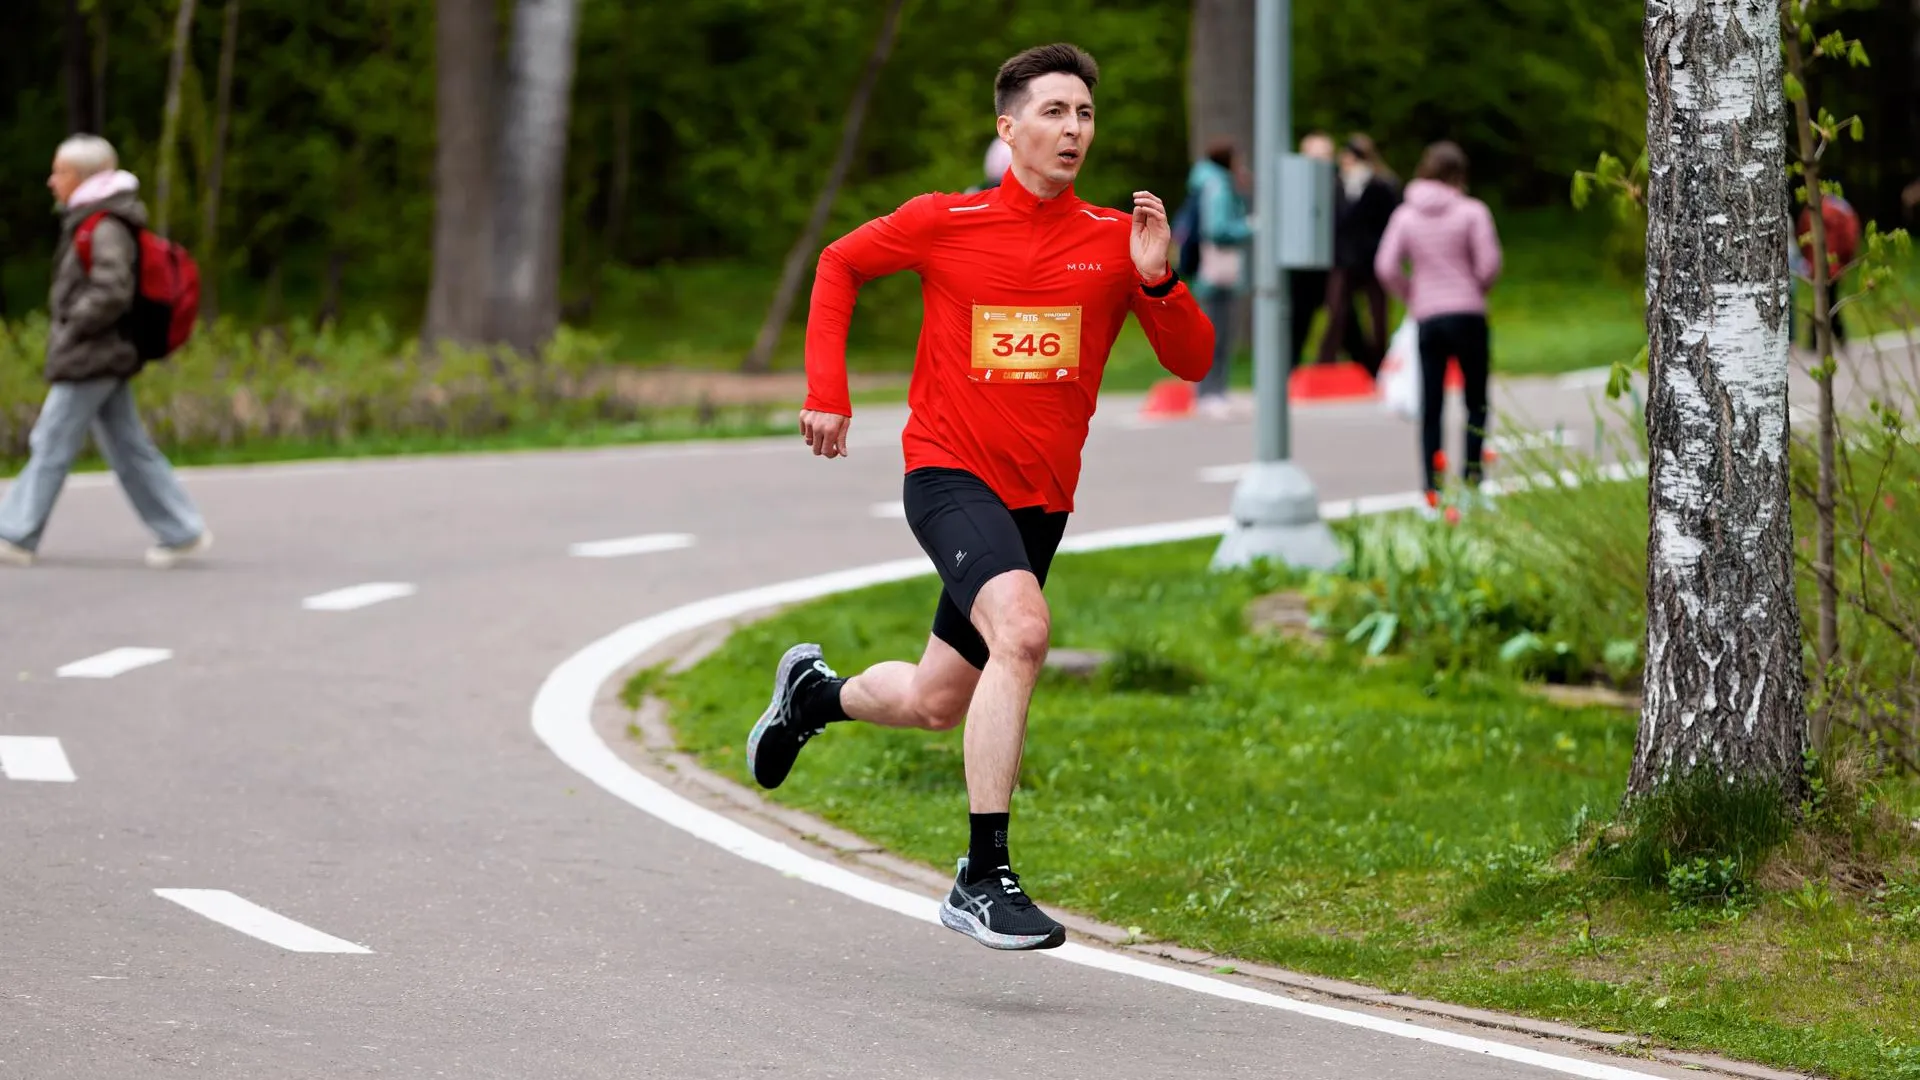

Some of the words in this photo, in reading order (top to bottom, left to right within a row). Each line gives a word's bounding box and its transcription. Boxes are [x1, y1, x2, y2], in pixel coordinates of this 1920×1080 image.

[1067, 263, 1102, 271] MOAX
[1022, 314, 1039, 322] ВТБ
[992, 333, 1061, 357] 346
